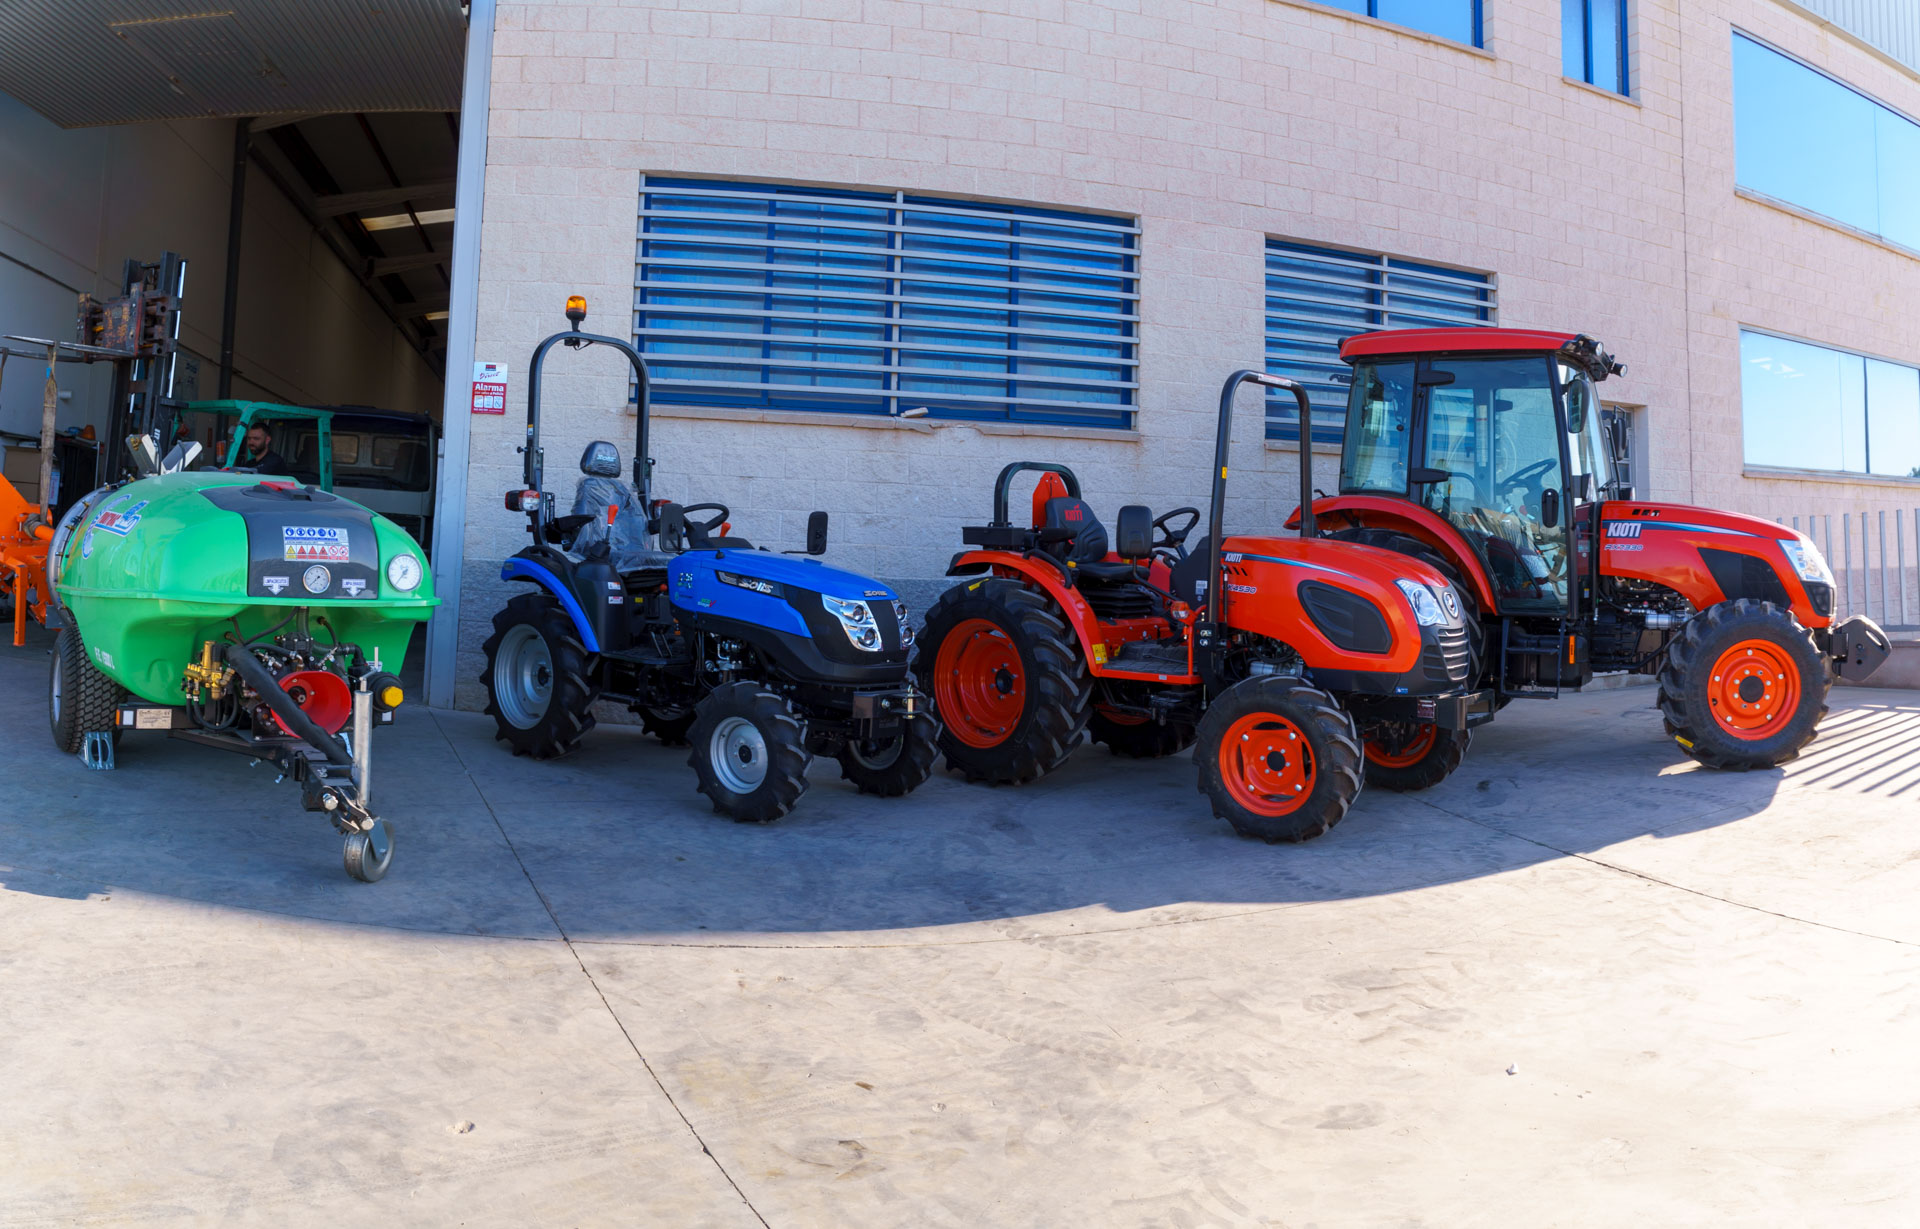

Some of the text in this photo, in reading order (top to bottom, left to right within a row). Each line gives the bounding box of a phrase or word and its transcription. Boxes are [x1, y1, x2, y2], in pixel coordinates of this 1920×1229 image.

[475, 383, 504, 391] Alarma
[1064, 509, 1083, 521] KIOTI
[1607, 522, 1642, 537] KIOTI
[1225, 553, 1243, 562] KIOTI
[1222, 584, 1257, 595] K4530
